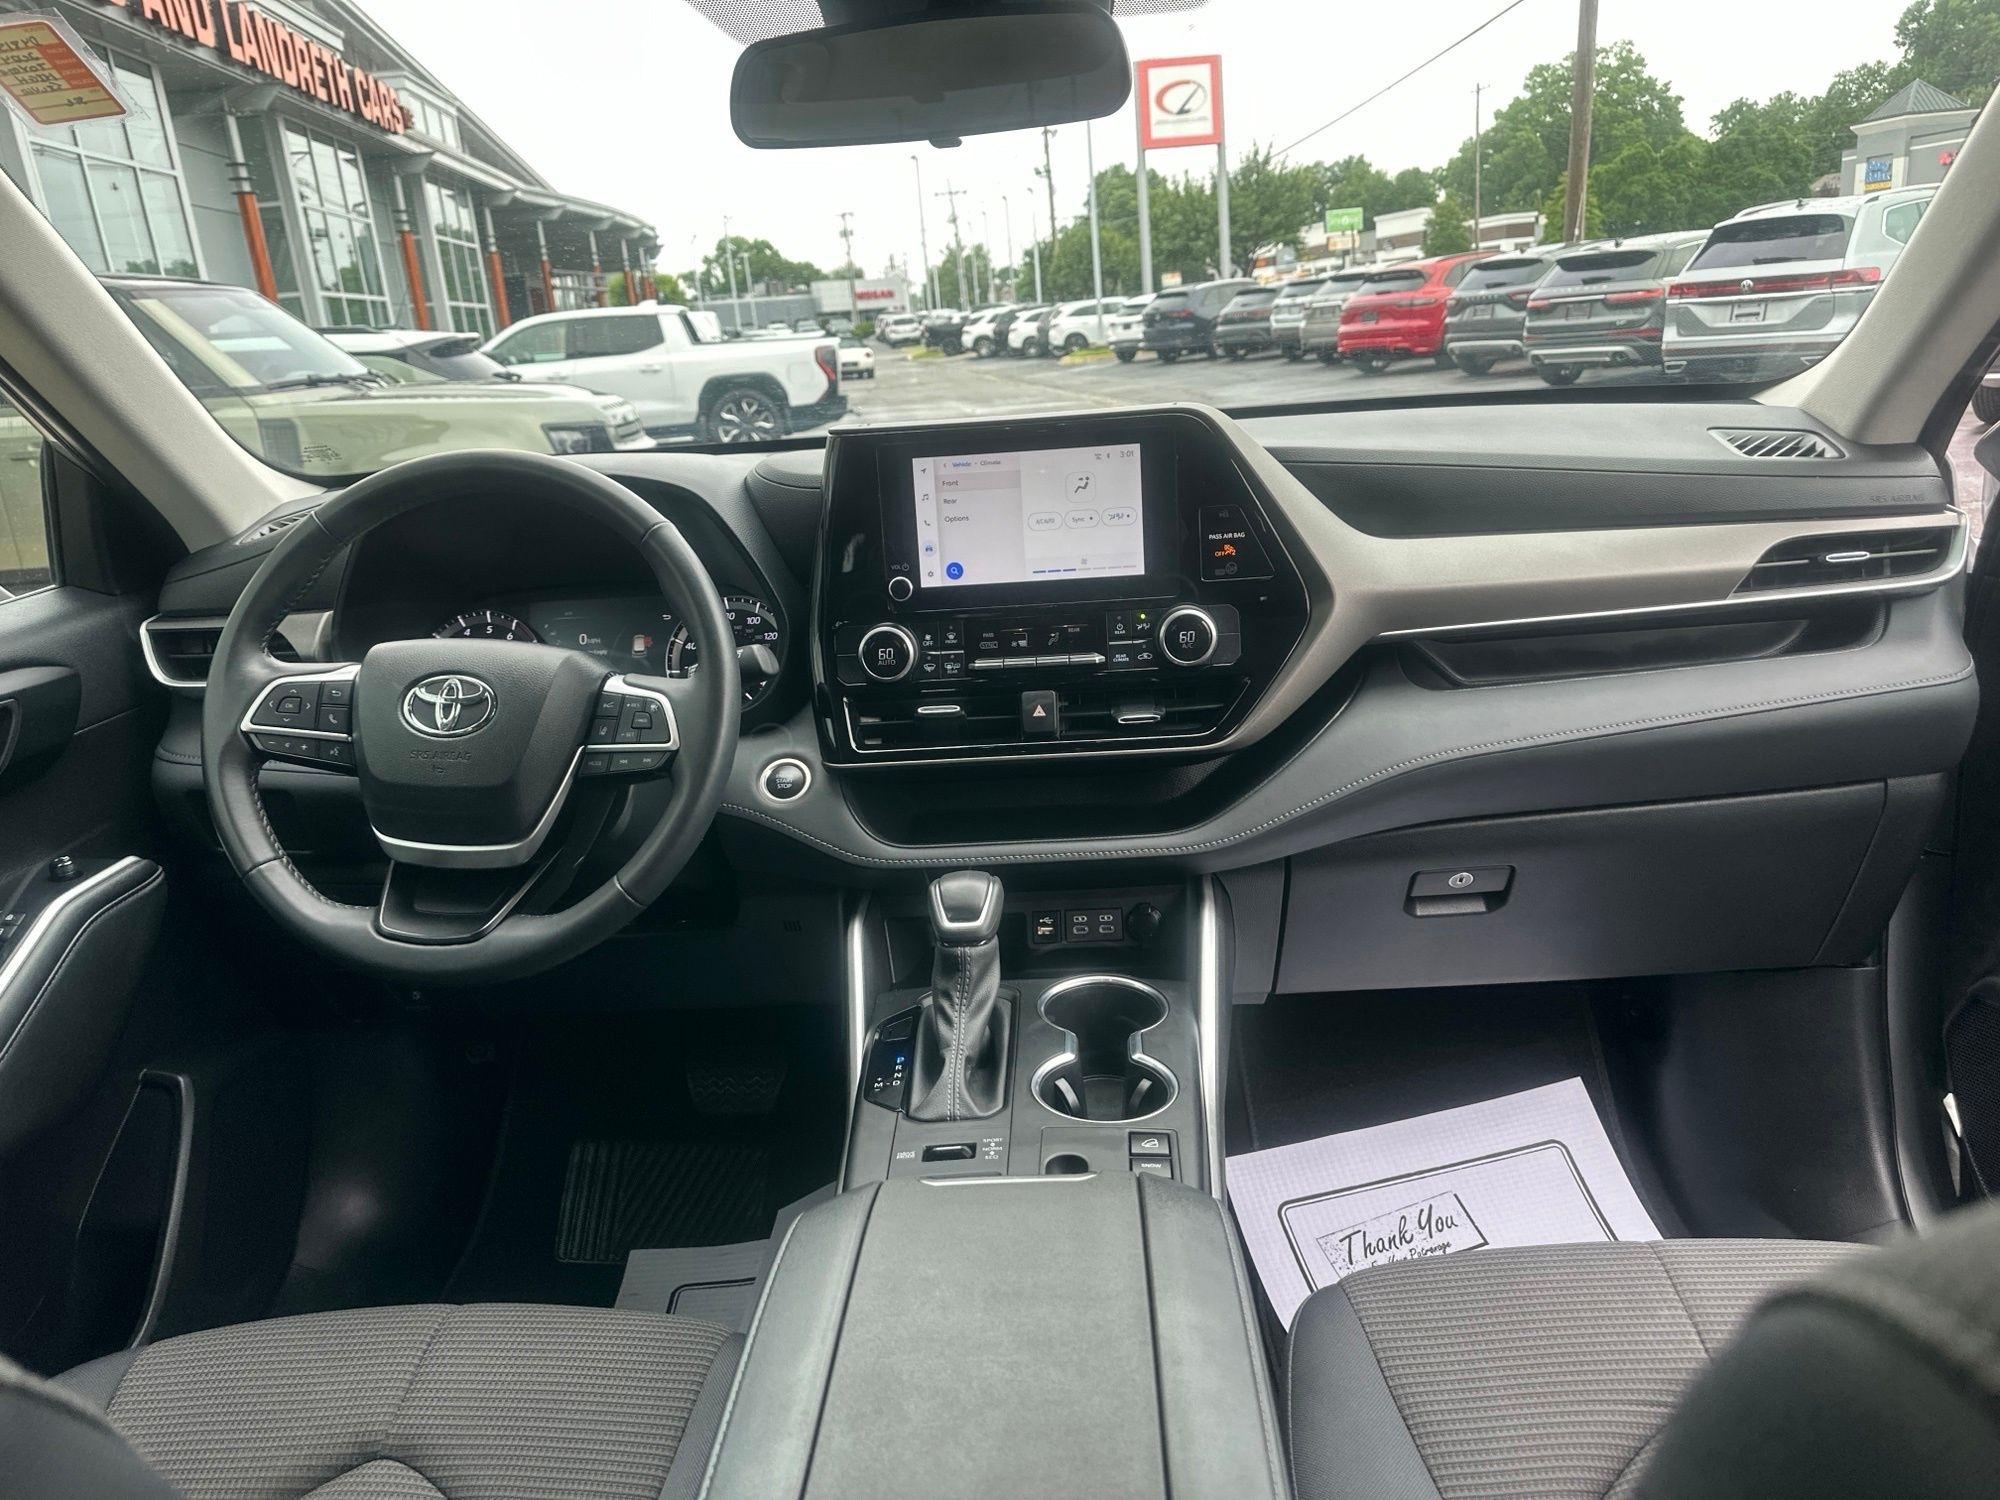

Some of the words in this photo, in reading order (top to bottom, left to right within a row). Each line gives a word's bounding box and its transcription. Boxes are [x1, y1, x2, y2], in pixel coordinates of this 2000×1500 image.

[221, 0, 355, 113] LANDRETH
[353, 67, 406, 135] CARS
[1120, 450, 1134, 458] 3:01
[463, 628, 471, 636] 4
[486, 625, 493, 634] 5
[506, 632, 514, 640] 6
[746, 616, 761, 624] 100
[763, 632, 778, 640] 120
[579, 633, 587, 645] 0
[1179, 631, 1195, 643] 60
[878, 648, 894, 660] 60
[896, 1056, 905, 1064] P
[1339, 1215, 1414, 1266] Thank
[1417, 1203, 1459, 1240] You
